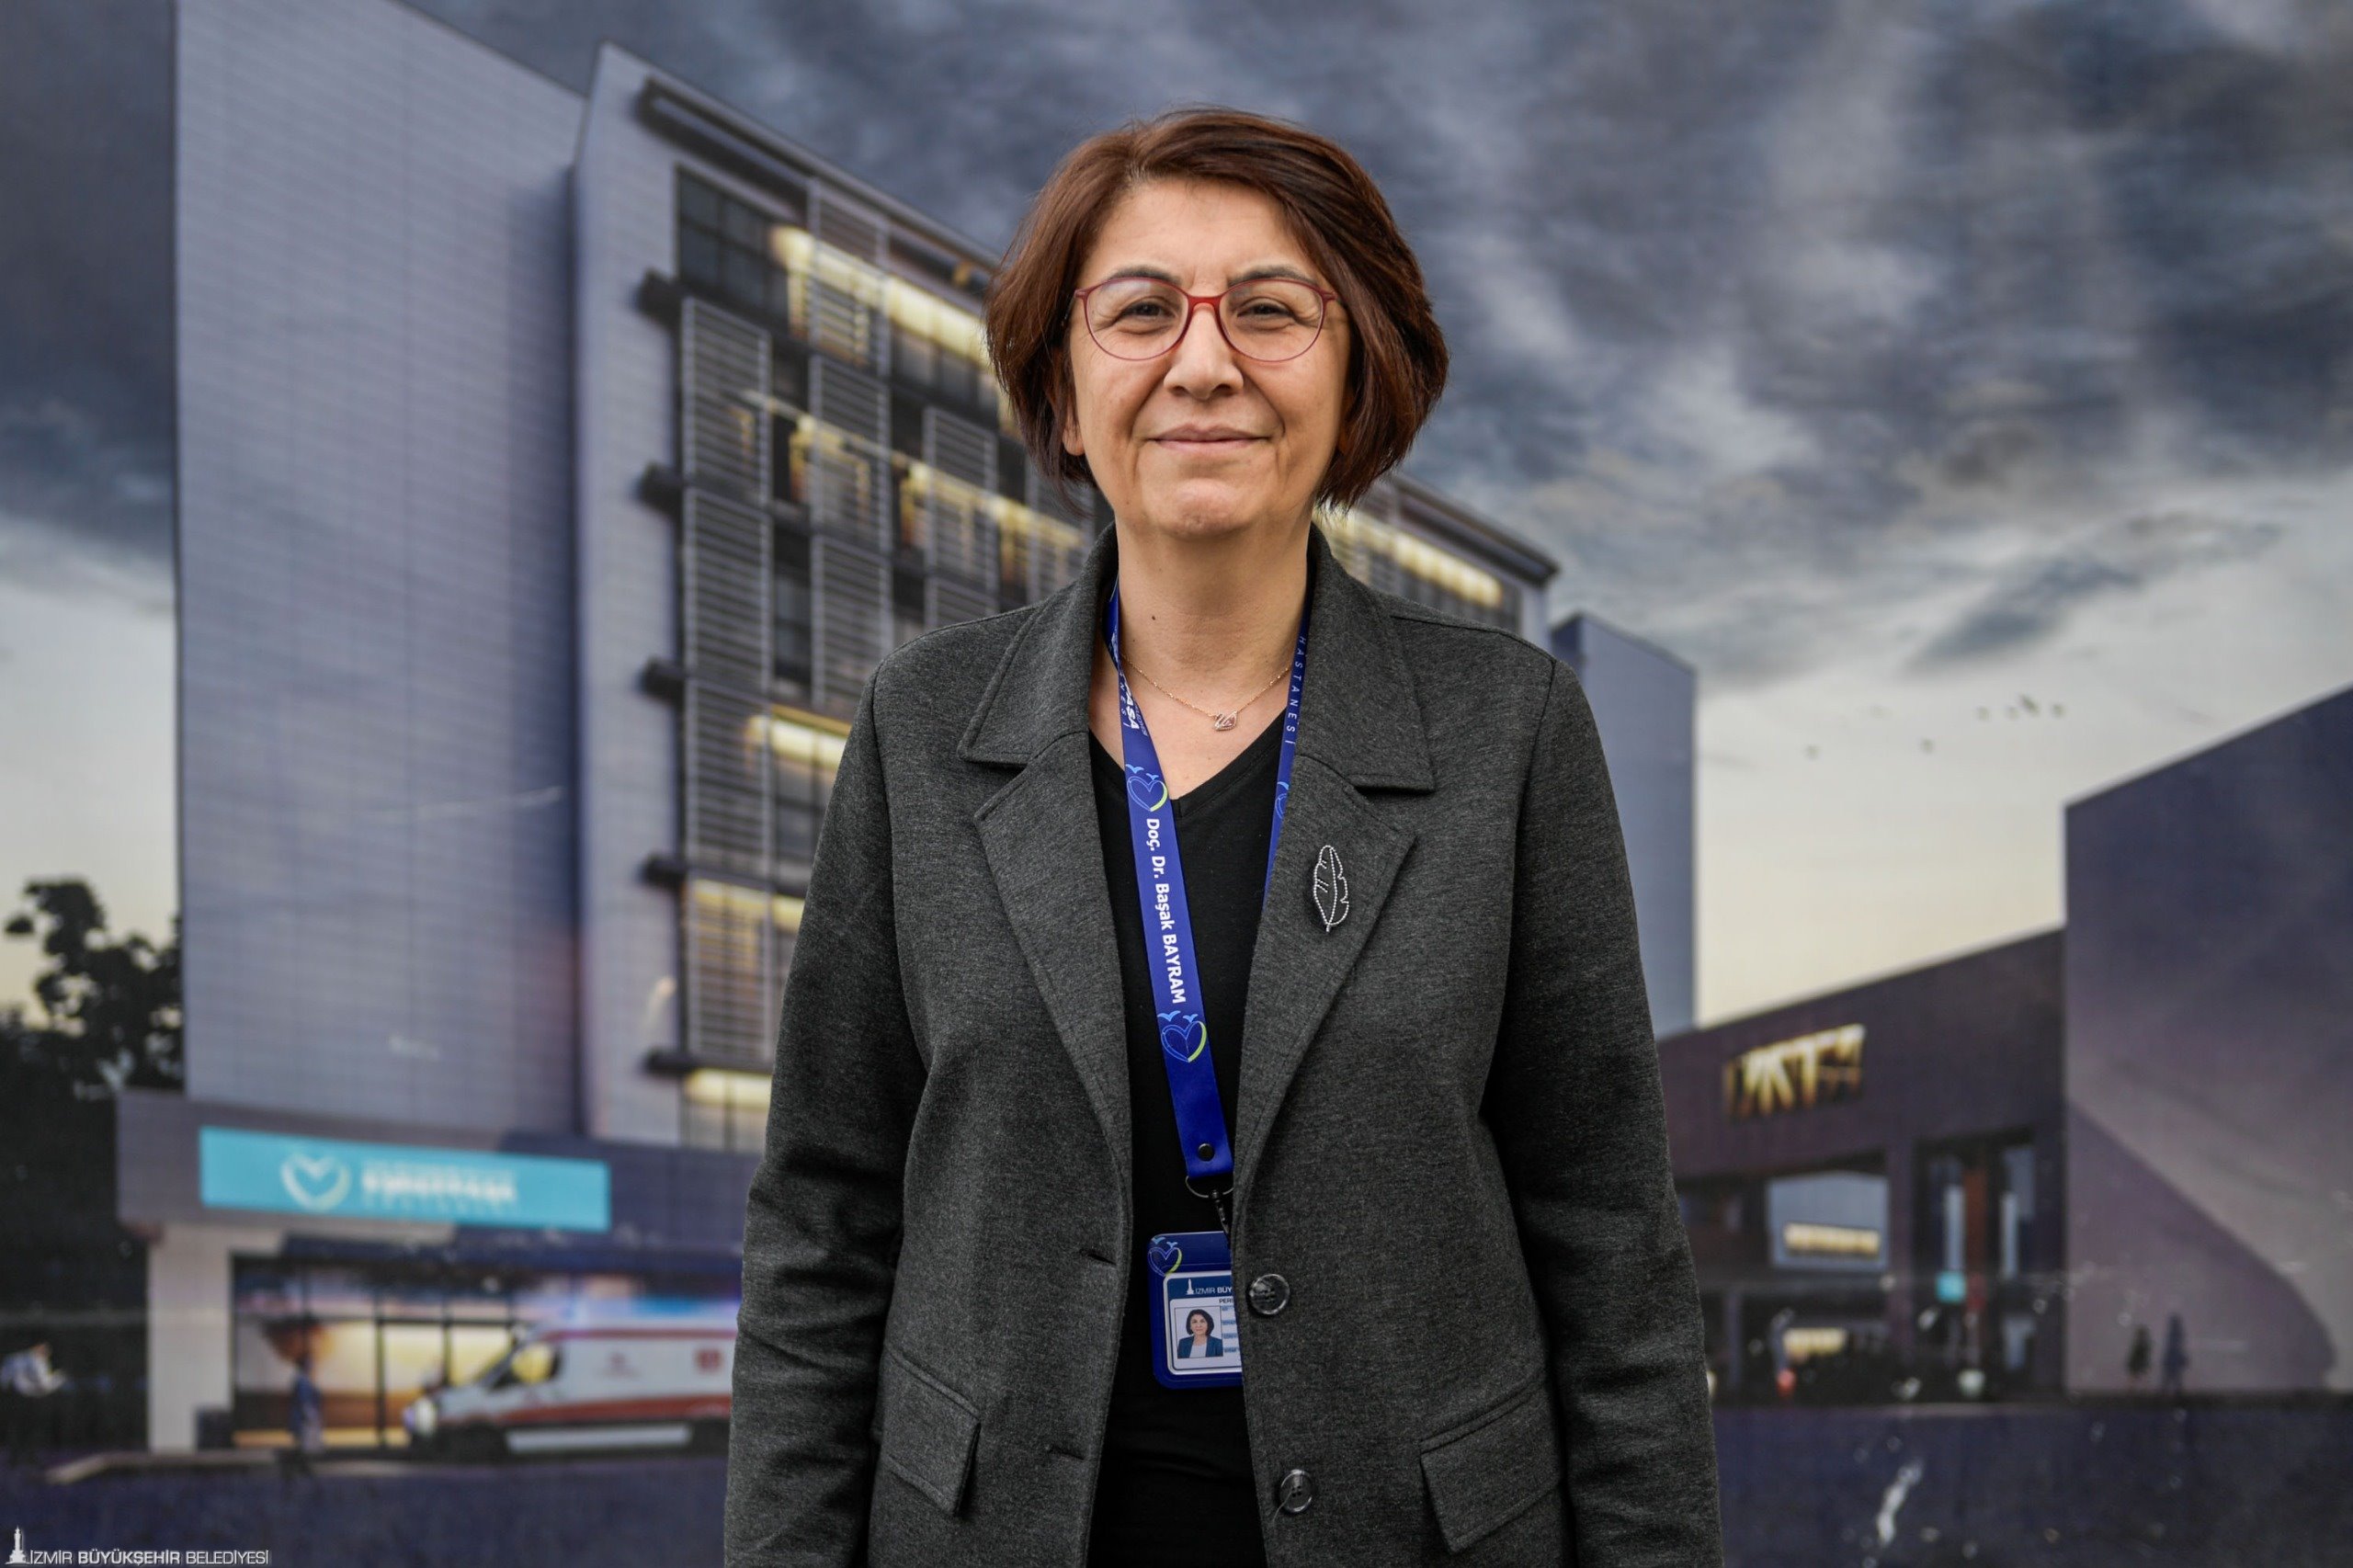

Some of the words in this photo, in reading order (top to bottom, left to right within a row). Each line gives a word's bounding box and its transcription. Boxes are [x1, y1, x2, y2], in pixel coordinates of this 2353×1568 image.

[1146, 818, 1160, 851] Doç.
[1152, 856, 1165, 879] Dr.
[1154, 883, 1176, 930] Başak
[1162, 934, 1187, 1004] BAYRAM
